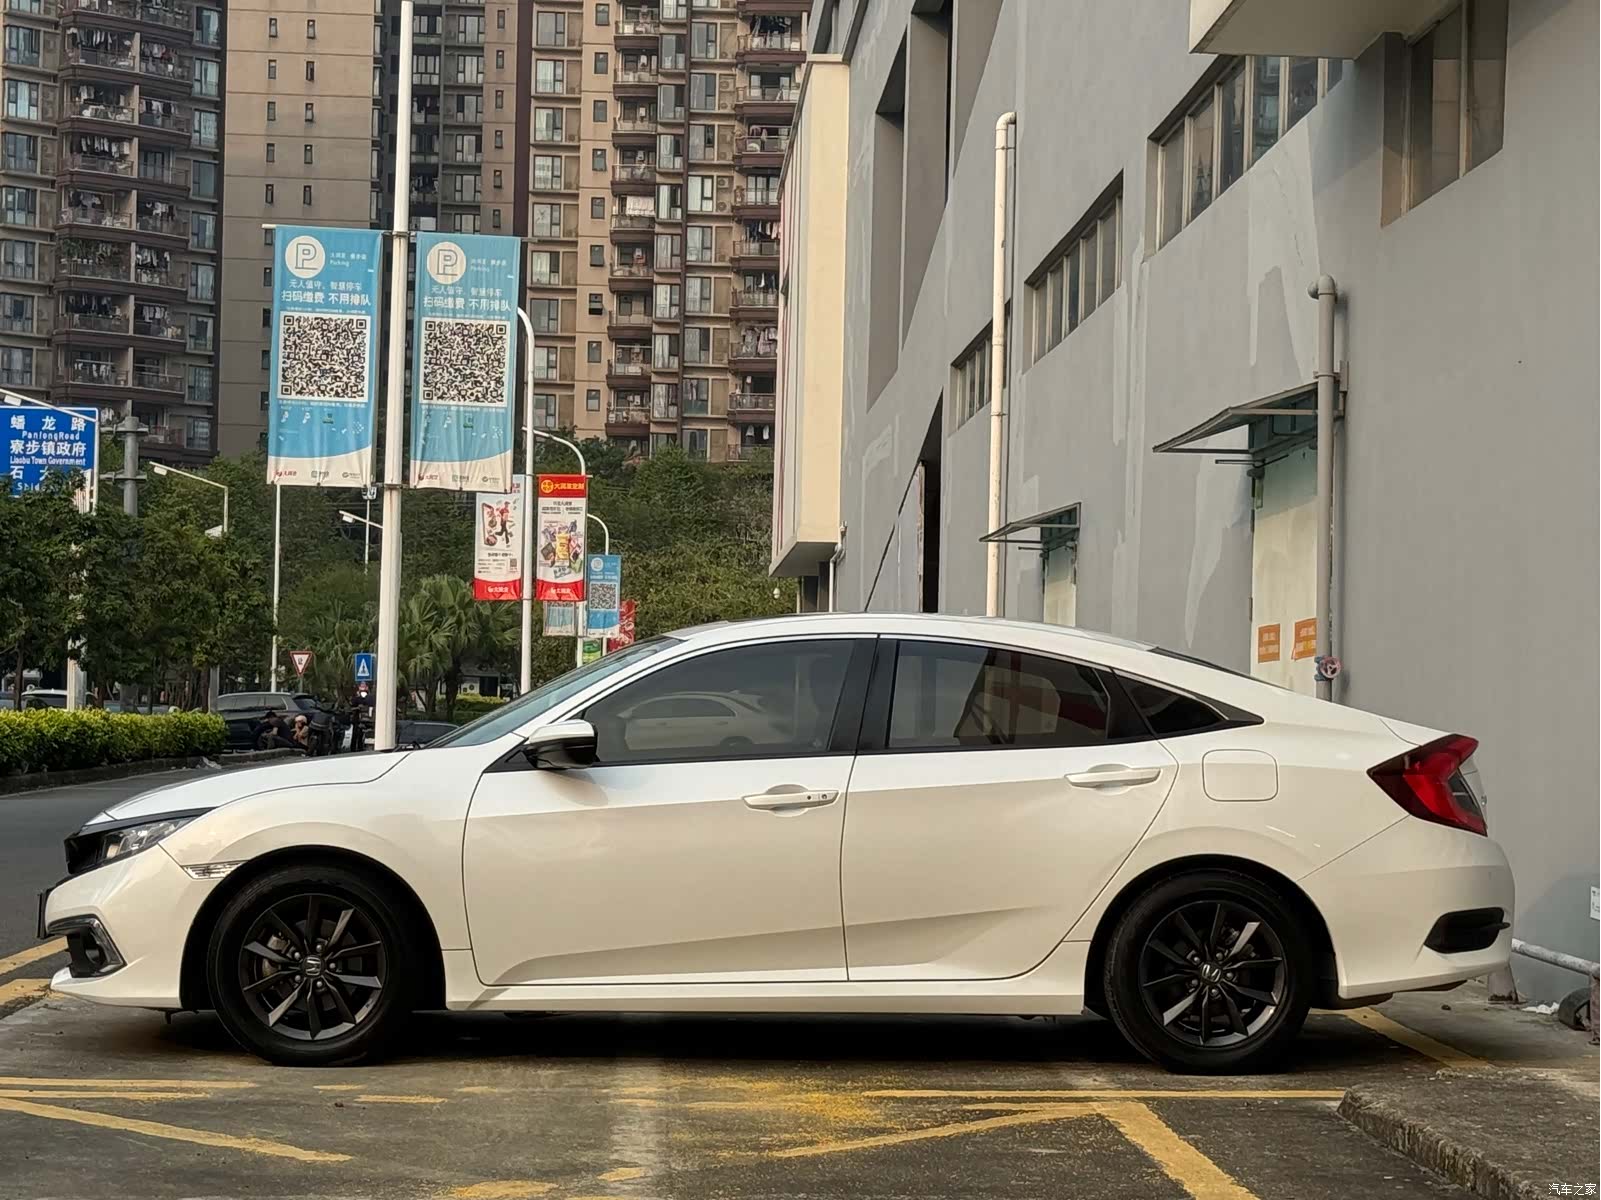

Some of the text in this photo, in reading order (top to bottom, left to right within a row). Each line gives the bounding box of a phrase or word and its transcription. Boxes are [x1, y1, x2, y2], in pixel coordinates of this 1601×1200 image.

[9, 439, 87, 456] 寮步镇政府
[10, 456, 86, 466] Liaobu Town Government
